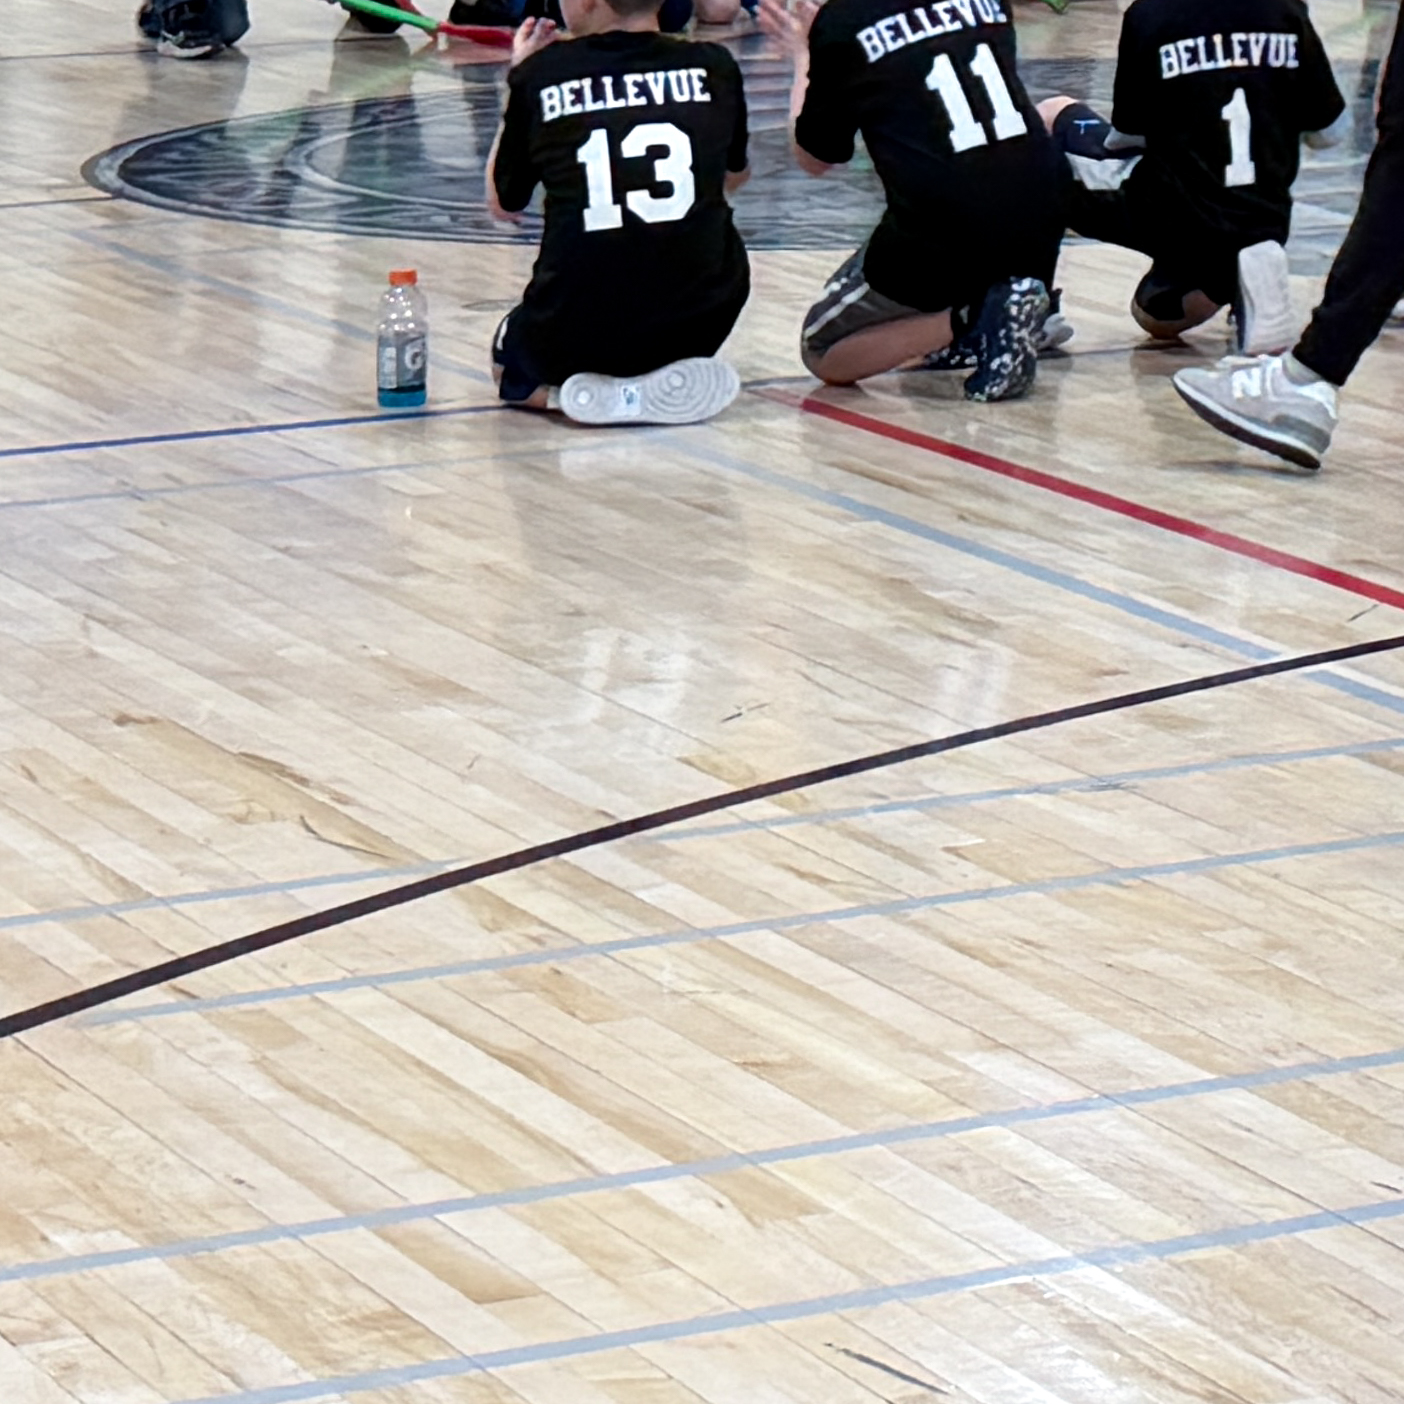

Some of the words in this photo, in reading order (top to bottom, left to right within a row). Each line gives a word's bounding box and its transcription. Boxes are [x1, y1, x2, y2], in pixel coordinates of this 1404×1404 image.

[540, 67, 712, 123] BELLEVUE
[925, 43, 1028, 153] 11
[1158, 32, 1300, 79] BELLEVUE
[576, 122, 696, 232] 13
[1221, 87, 1256, 187] 1
